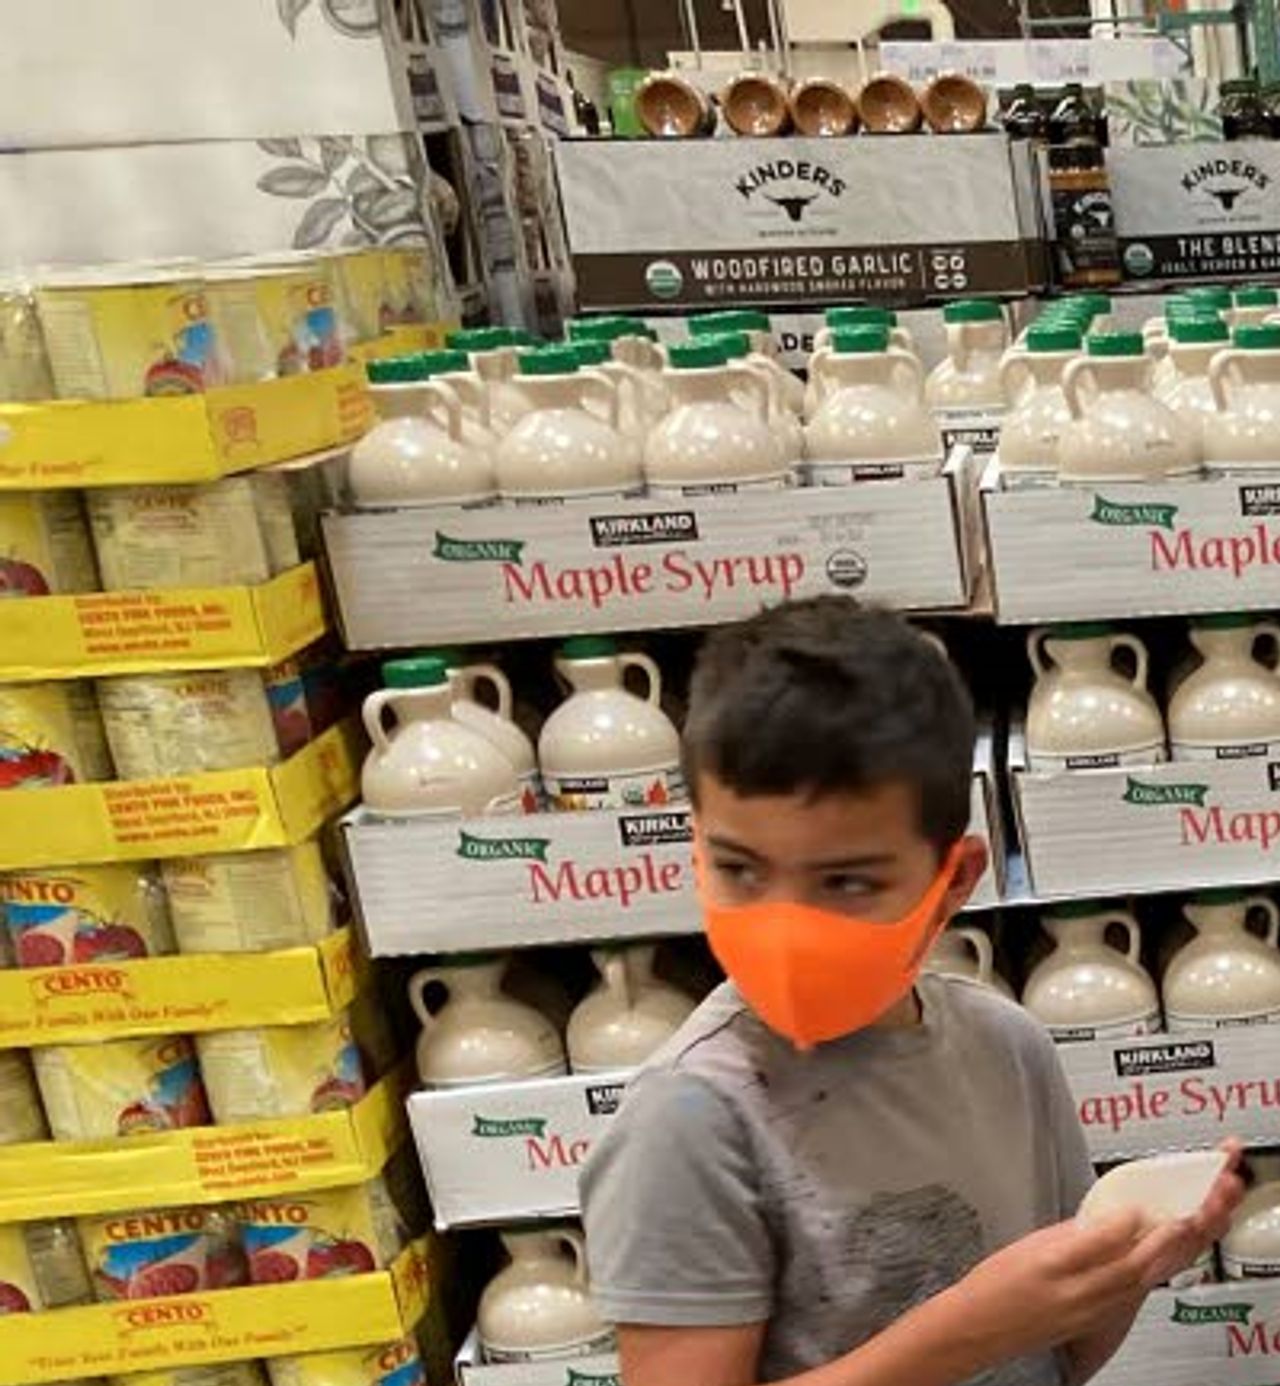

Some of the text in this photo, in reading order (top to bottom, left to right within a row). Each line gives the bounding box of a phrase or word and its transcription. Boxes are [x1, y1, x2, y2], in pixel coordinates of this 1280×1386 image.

[736, 159, 846, 198] KINDERS
[1181, 160, 1270, 191] KINDERS
[1178, 237, 1215, 258] THE
[691, 255, 823, 279] WOODFIRED
[832, 253, 913, 275] GARLIC
[595, 514, 693, 537] KIRKLAND
[502, 547, 805, 609] Maple Syrup
[528, 854, 682, 907] Maple
[45, 972, 123, 991] CENTO
[1119, 1044, 1210, 1066] KIRKLAND
[1080, 1082, 1170, 1132] aple
[106, 1208, 201, 1240] CENTO
[127, 1304, 204, 1325] CENTO
